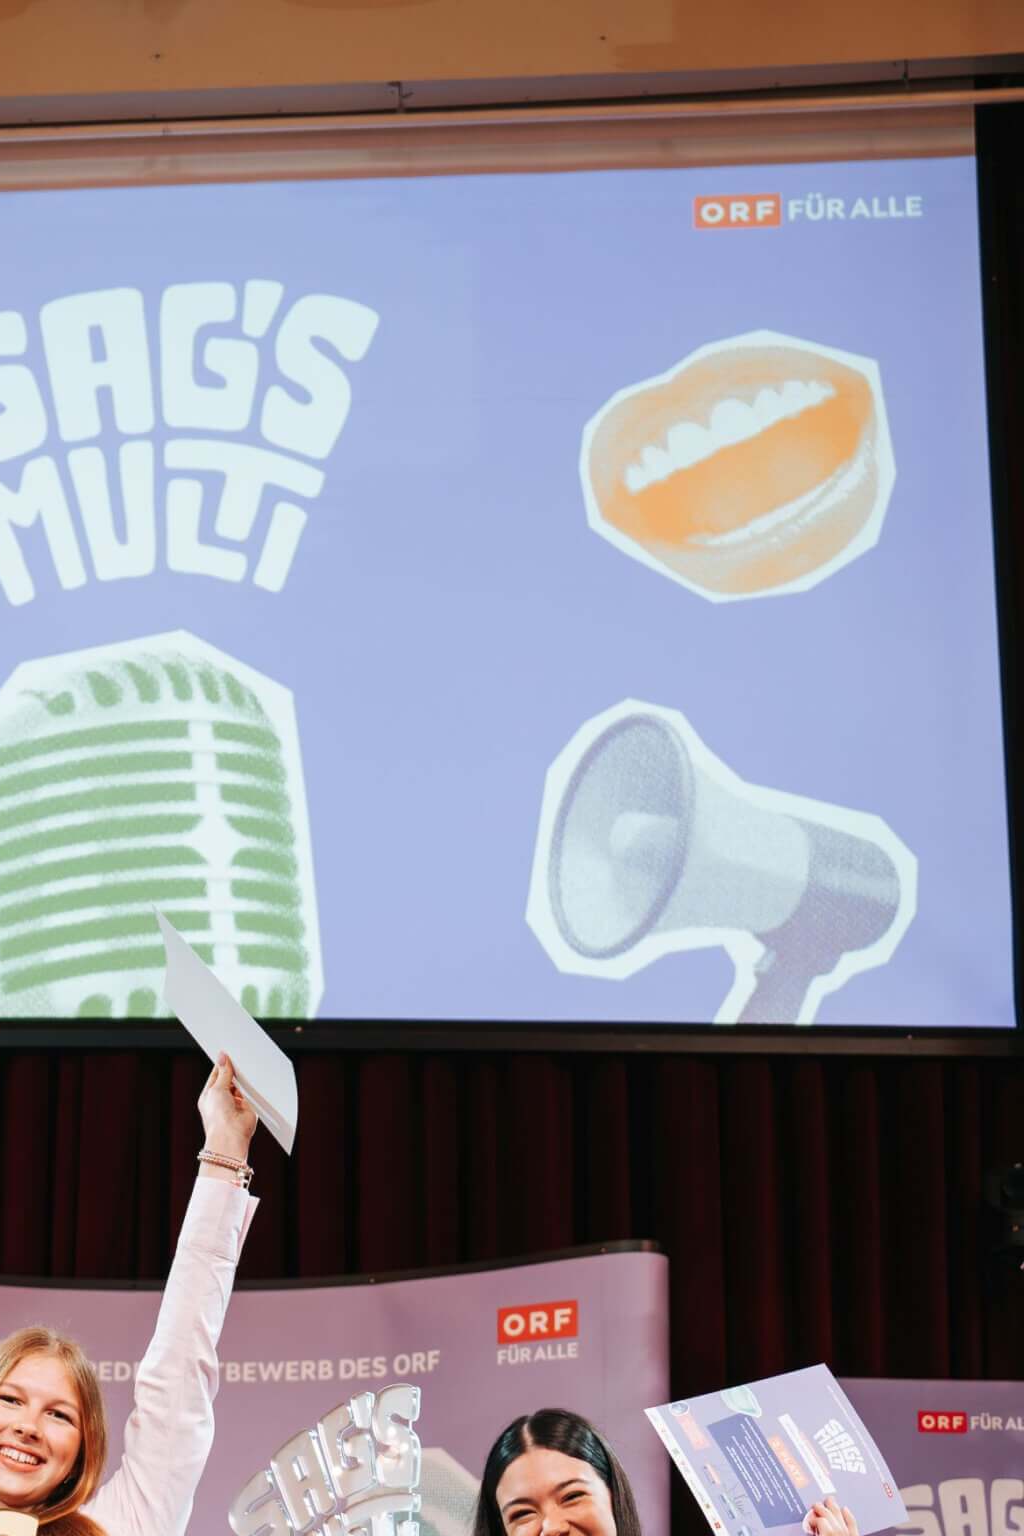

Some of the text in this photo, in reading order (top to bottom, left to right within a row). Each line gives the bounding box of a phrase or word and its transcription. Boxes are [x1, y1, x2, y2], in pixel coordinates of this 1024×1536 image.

[700, 193, 923, 223] ORF FÜR ALLE
[503, 1307, 573, 1337] ORF
[339, 1357, 387, 1379] DES
[393, 1350, 441, 1375] ORF
[497, 1342, 579, 1365] FÜR ALLE
[921, 1411, 1024, 1431] ORF FÜR AL
